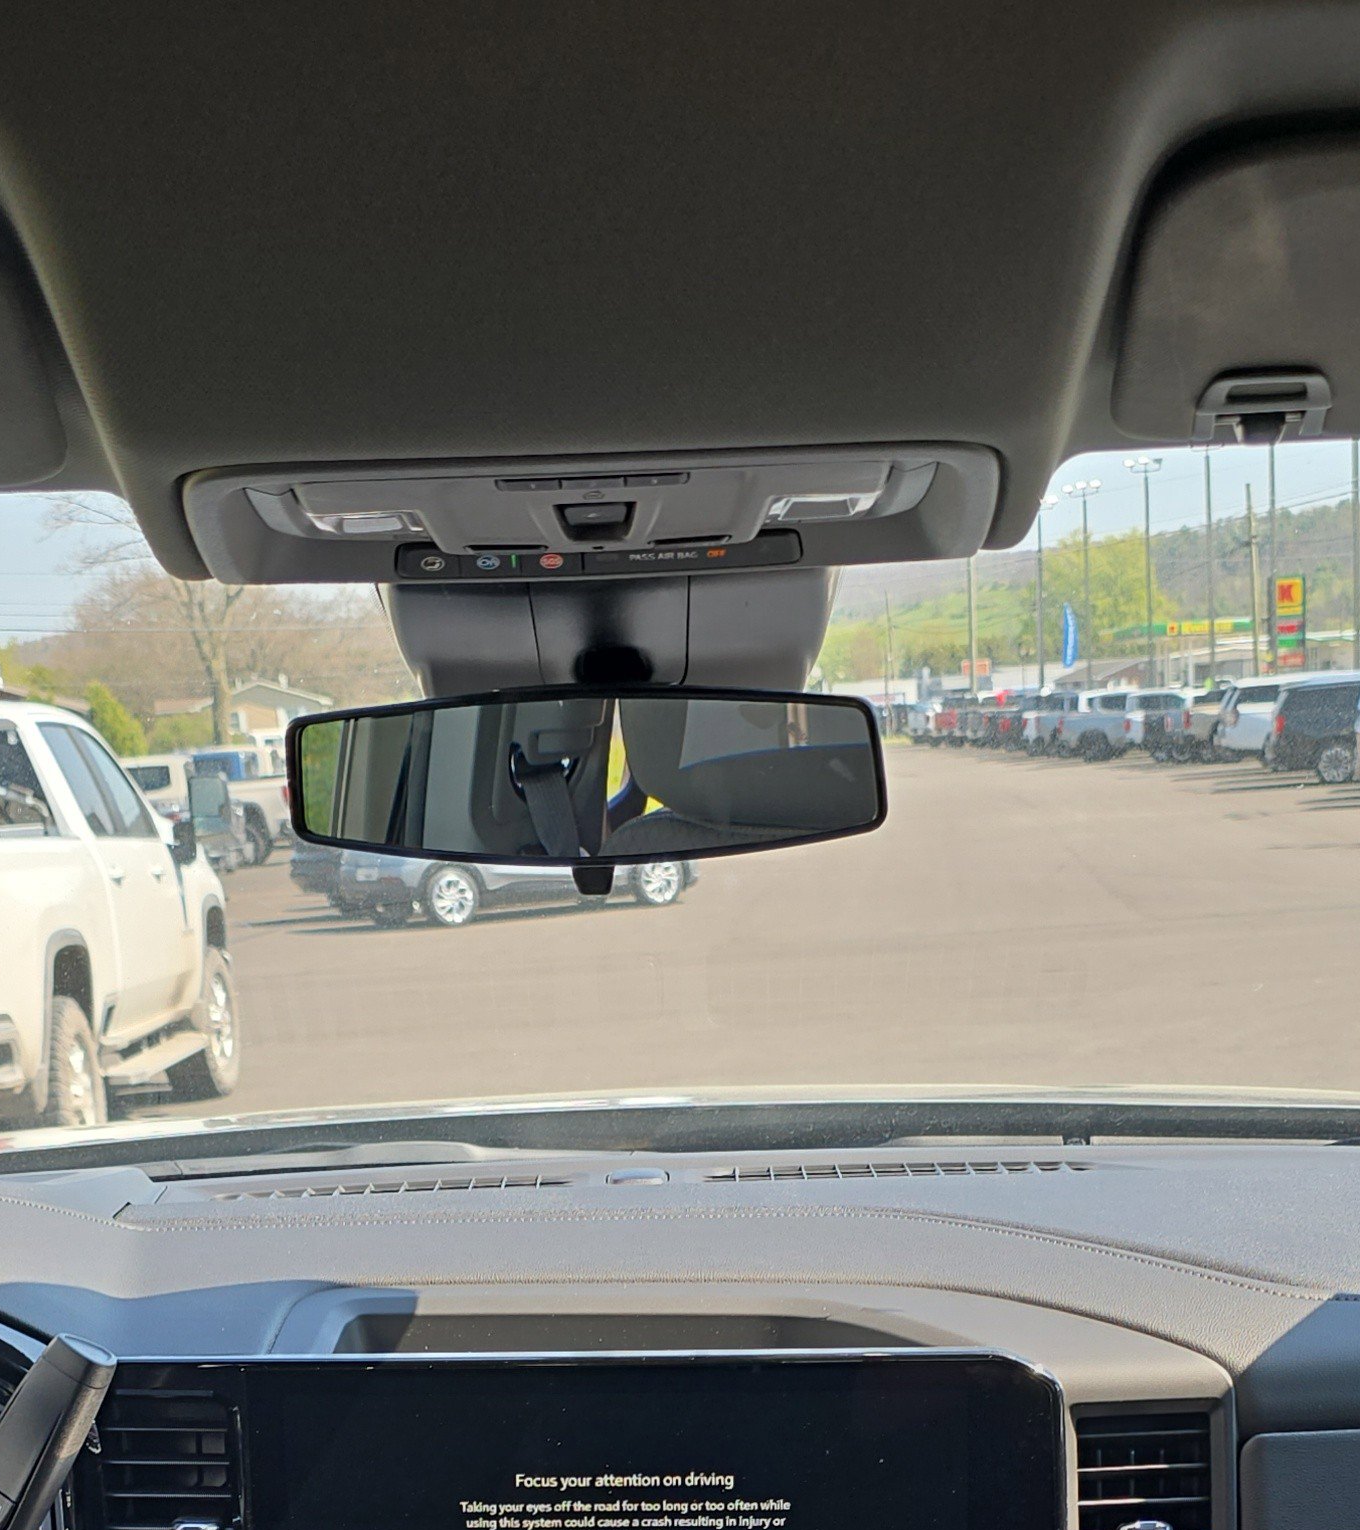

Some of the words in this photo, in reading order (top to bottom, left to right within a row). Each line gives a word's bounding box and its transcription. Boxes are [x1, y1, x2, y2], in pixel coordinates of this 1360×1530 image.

[629, 552, 655, 562] PASS
[658, 551, 675, 560] AIR
[677, 549, 698, 560] BAG
[707, 548, 726, 558] OFF
[515, 1474, 558, 1487] Focus
[560, 1476, 592, 1491] your
[595, 1473, 660, 1487] attention
[663, 1476, 681, 1487] on
[685, 1472, 734, 1489] driving
[460, 1501, 497, 1515] Taking
[498, 1504, 524, 1515] your
[526, 1503, 552, 1515] eyes
[554, 1500, 571, 1511] off
[573, 1501, 592, 1511] the
[594, 1500, 620, 1511] road
[622, 1500, 639, 1511] for
[641, 1501, 660, 1511] too
[662, 1500, 688, 1514] long
[690, 1502, 703, 1511] or
[705, 1500, 725, 1510] too
[727, 1499, 758, 1511] often
[760, 1499, 791, 1510] while
[466, 1518, 497, 1530] using
[499, 1517, 520, 1528] this
[522, 1518, 562, 1530] system
[564, 1516, 595, 1527] could
[597, 1518, 630, 1527] cause
[632, 1519, 639, 1527] a
[641, 1516, 671, 1527] crash
[674, 1516, 723, 1529] resulting
[726, 1516, 736, 1526] in
[739, 1516, 771, 1529] injury
[773, 1518, 786, 1526] or
